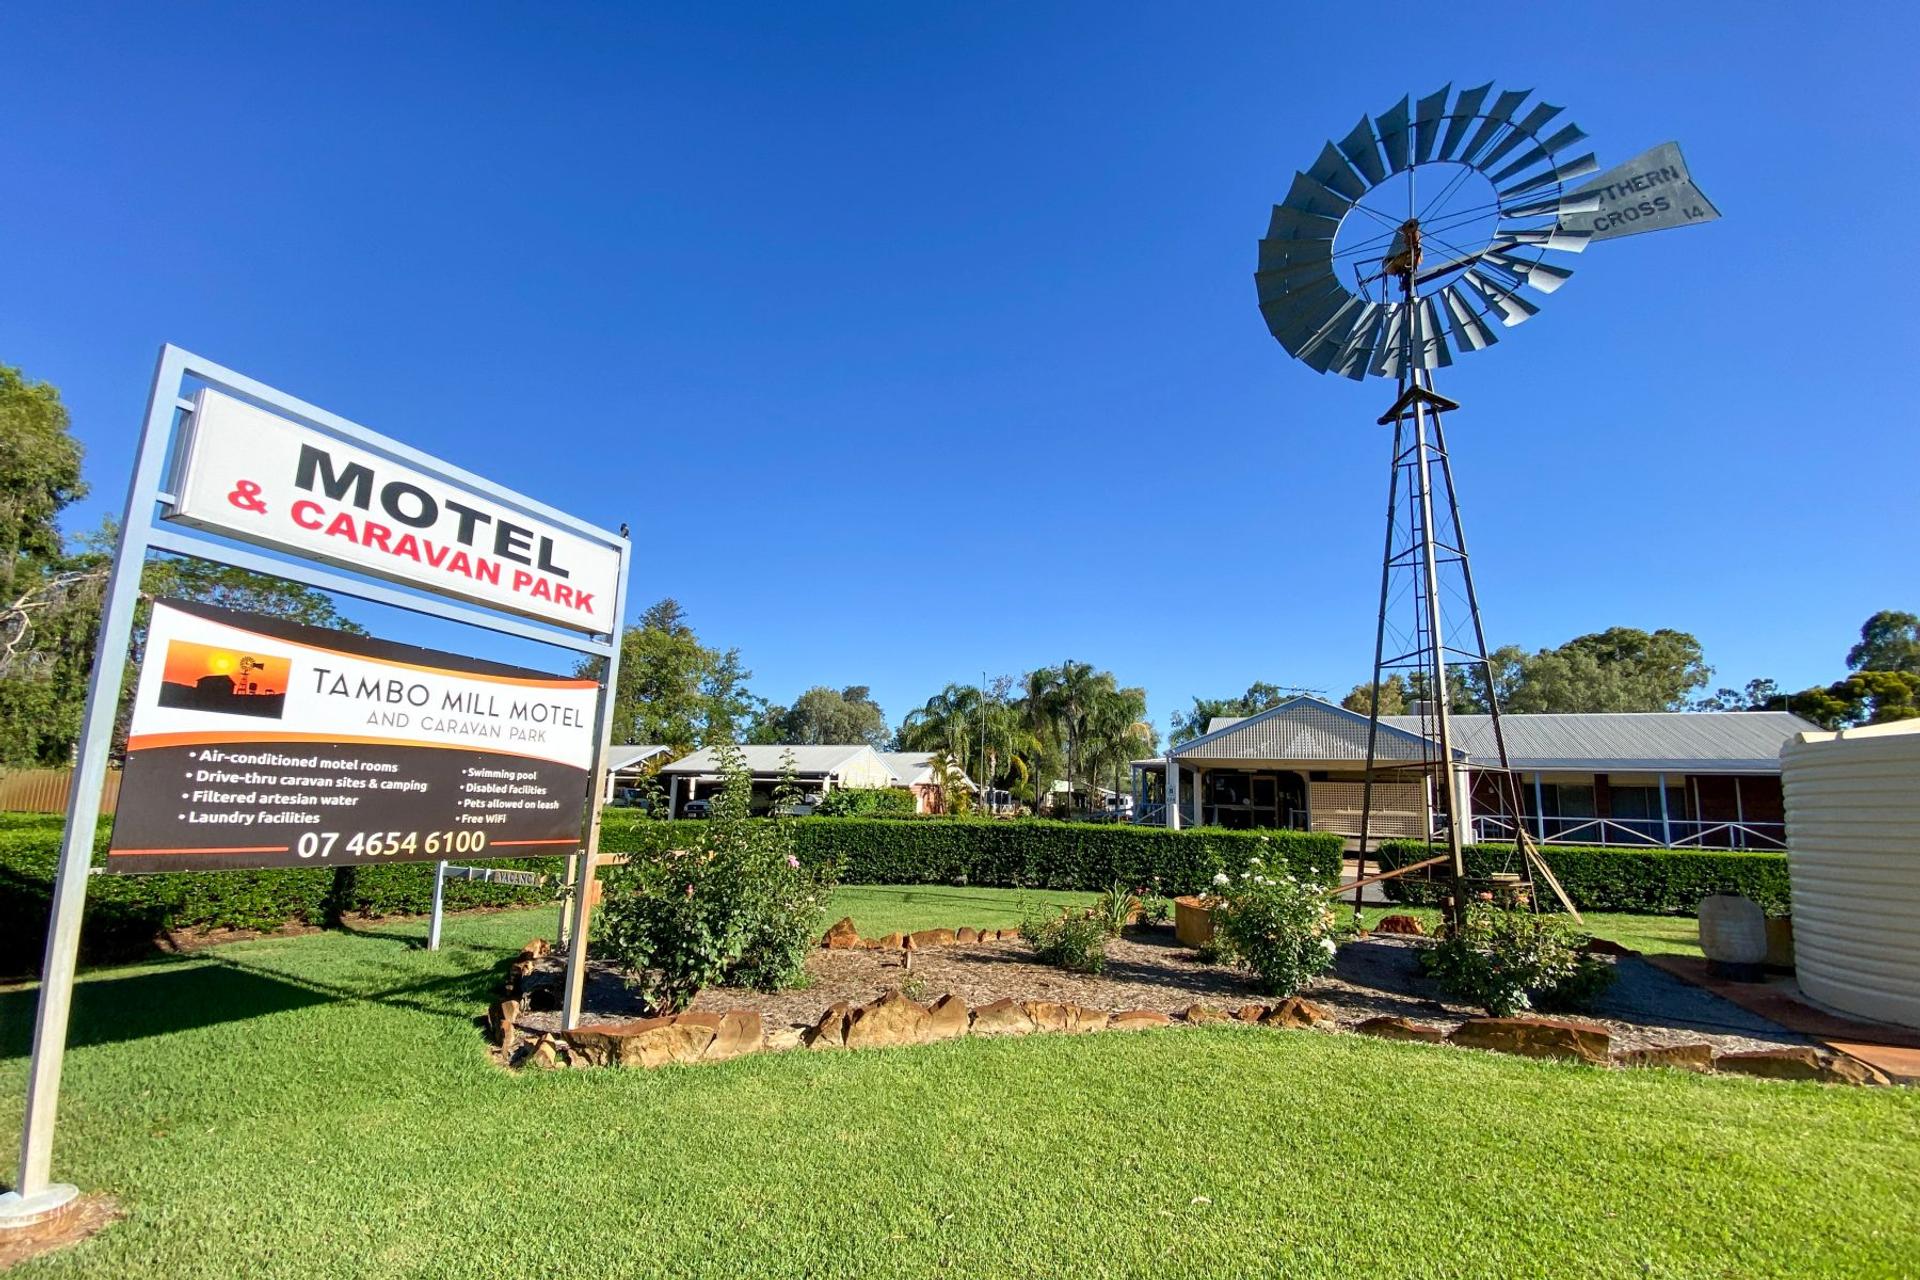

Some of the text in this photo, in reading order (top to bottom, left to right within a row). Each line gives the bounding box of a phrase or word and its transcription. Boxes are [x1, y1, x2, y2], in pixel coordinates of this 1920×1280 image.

[1593, 196, 1671, 232] CROSS
[1682, 204, 1705, 220] 14
[294, 443, 570, 579] MOTEL
[227, 479, 595, 615] & CARAVAN PARK
[313, 667, 584, 729] TAMBO MILL MOTEL
[366, 709, 547, 744] AND CARAVAN PARK
[198, 749, 399, 773] Air-conditioned motel rooms
[196, 769, 428, 793] Drive-thru caravan sites & camping
[467, 767, 537, 781] Swimming pool
[192, 790, 360, 806] Filtered artesian water
[465, 783, 548, 796] Disabled facilities
[463, 799, 486, 809] Pets
[487, 799, 523, 810] allowed
[537, 801, 560, 810] leash
[188, 810, 321, 826] Laundry facilities
[461, 814, 484, 824] Free
[297, 830, 486, 858] 07 4654 6100
